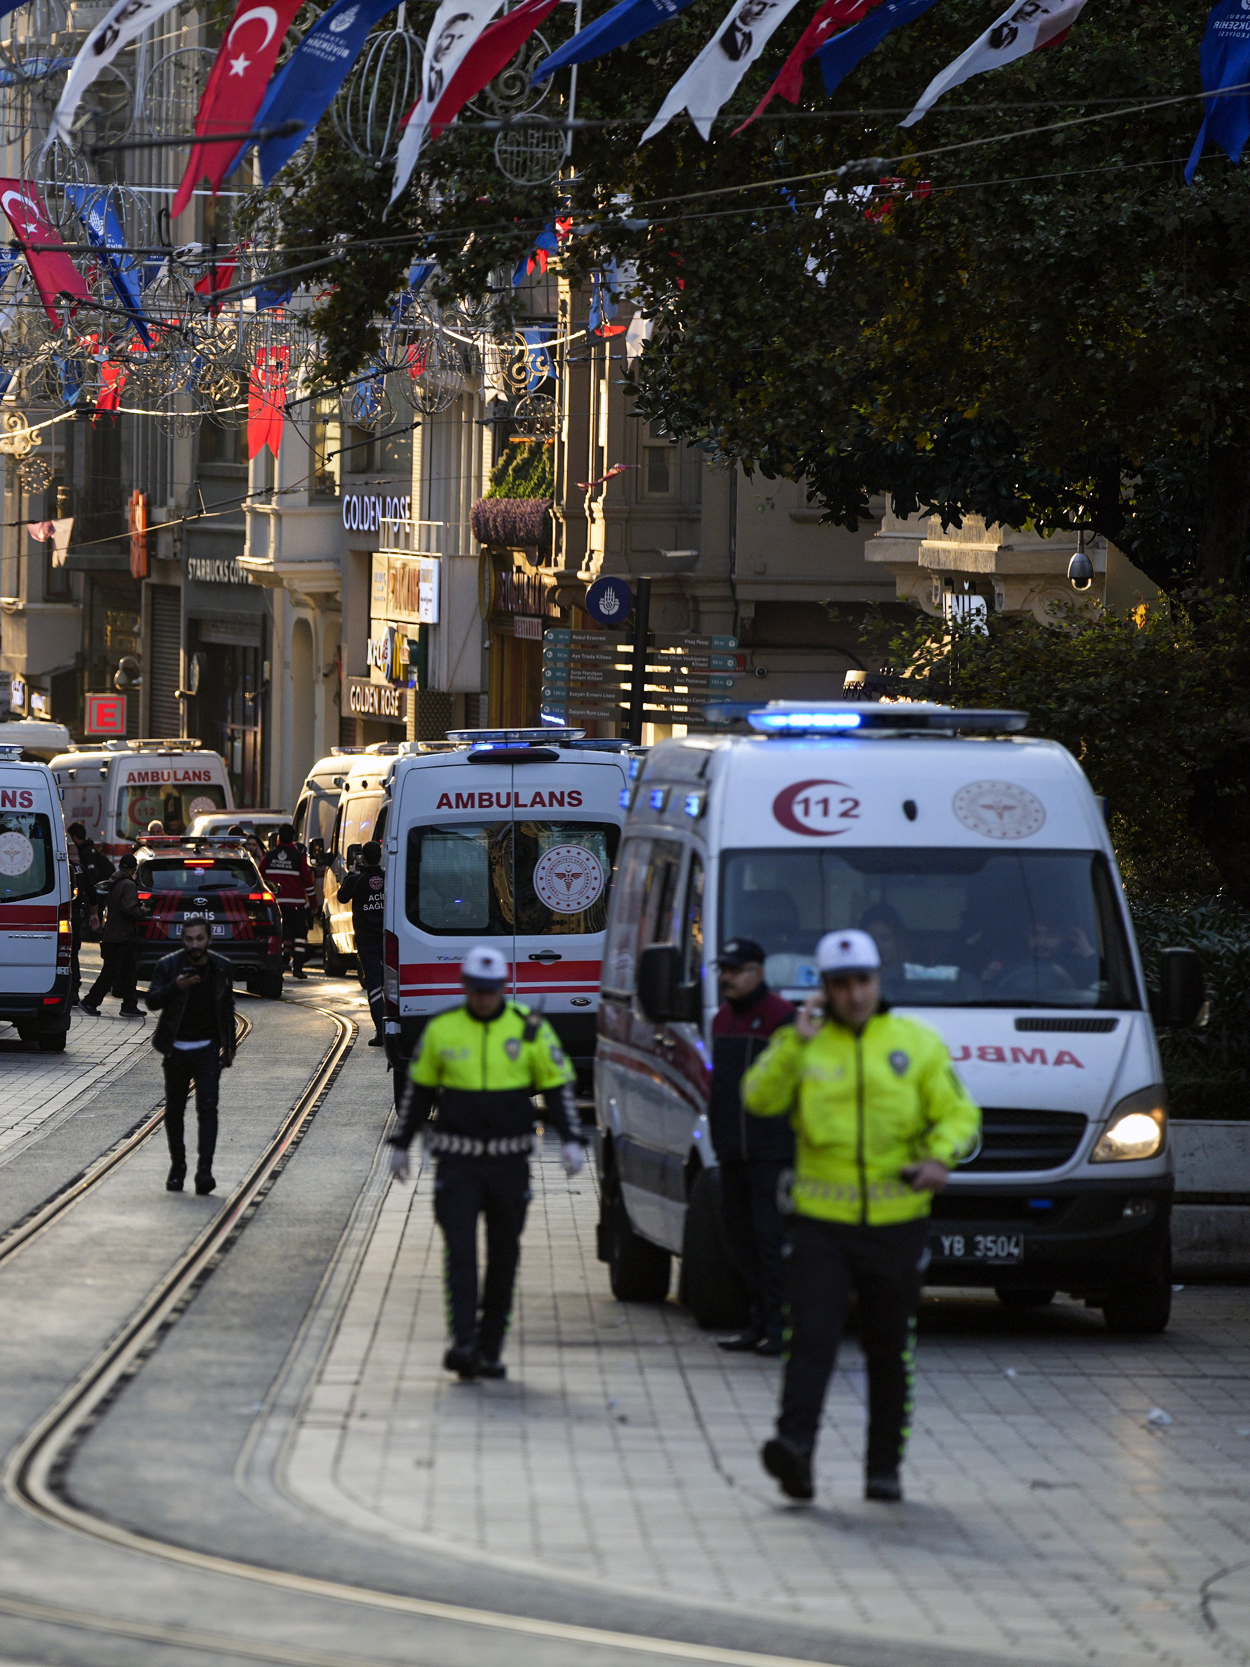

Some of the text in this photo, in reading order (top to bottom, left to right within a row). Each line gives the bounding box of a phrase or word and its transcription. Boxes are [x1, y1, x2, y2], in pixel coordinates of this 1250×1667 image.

[342, 494, 411, 533] GOLDEN ROSE
[188, 557, 229, 583] STARBUCKS
[350, 685, 400, 717] GOLDEN ROSE
[97, 703, 118, 727] E
[126, 770, 212, 784] AMBULANS
[436, 790, 583, 809] AMBULANS
[795, 797, 861, 819] 112
[136, 807, 156, 816] 112
[974, 1234, 1021, 1257] 3504
